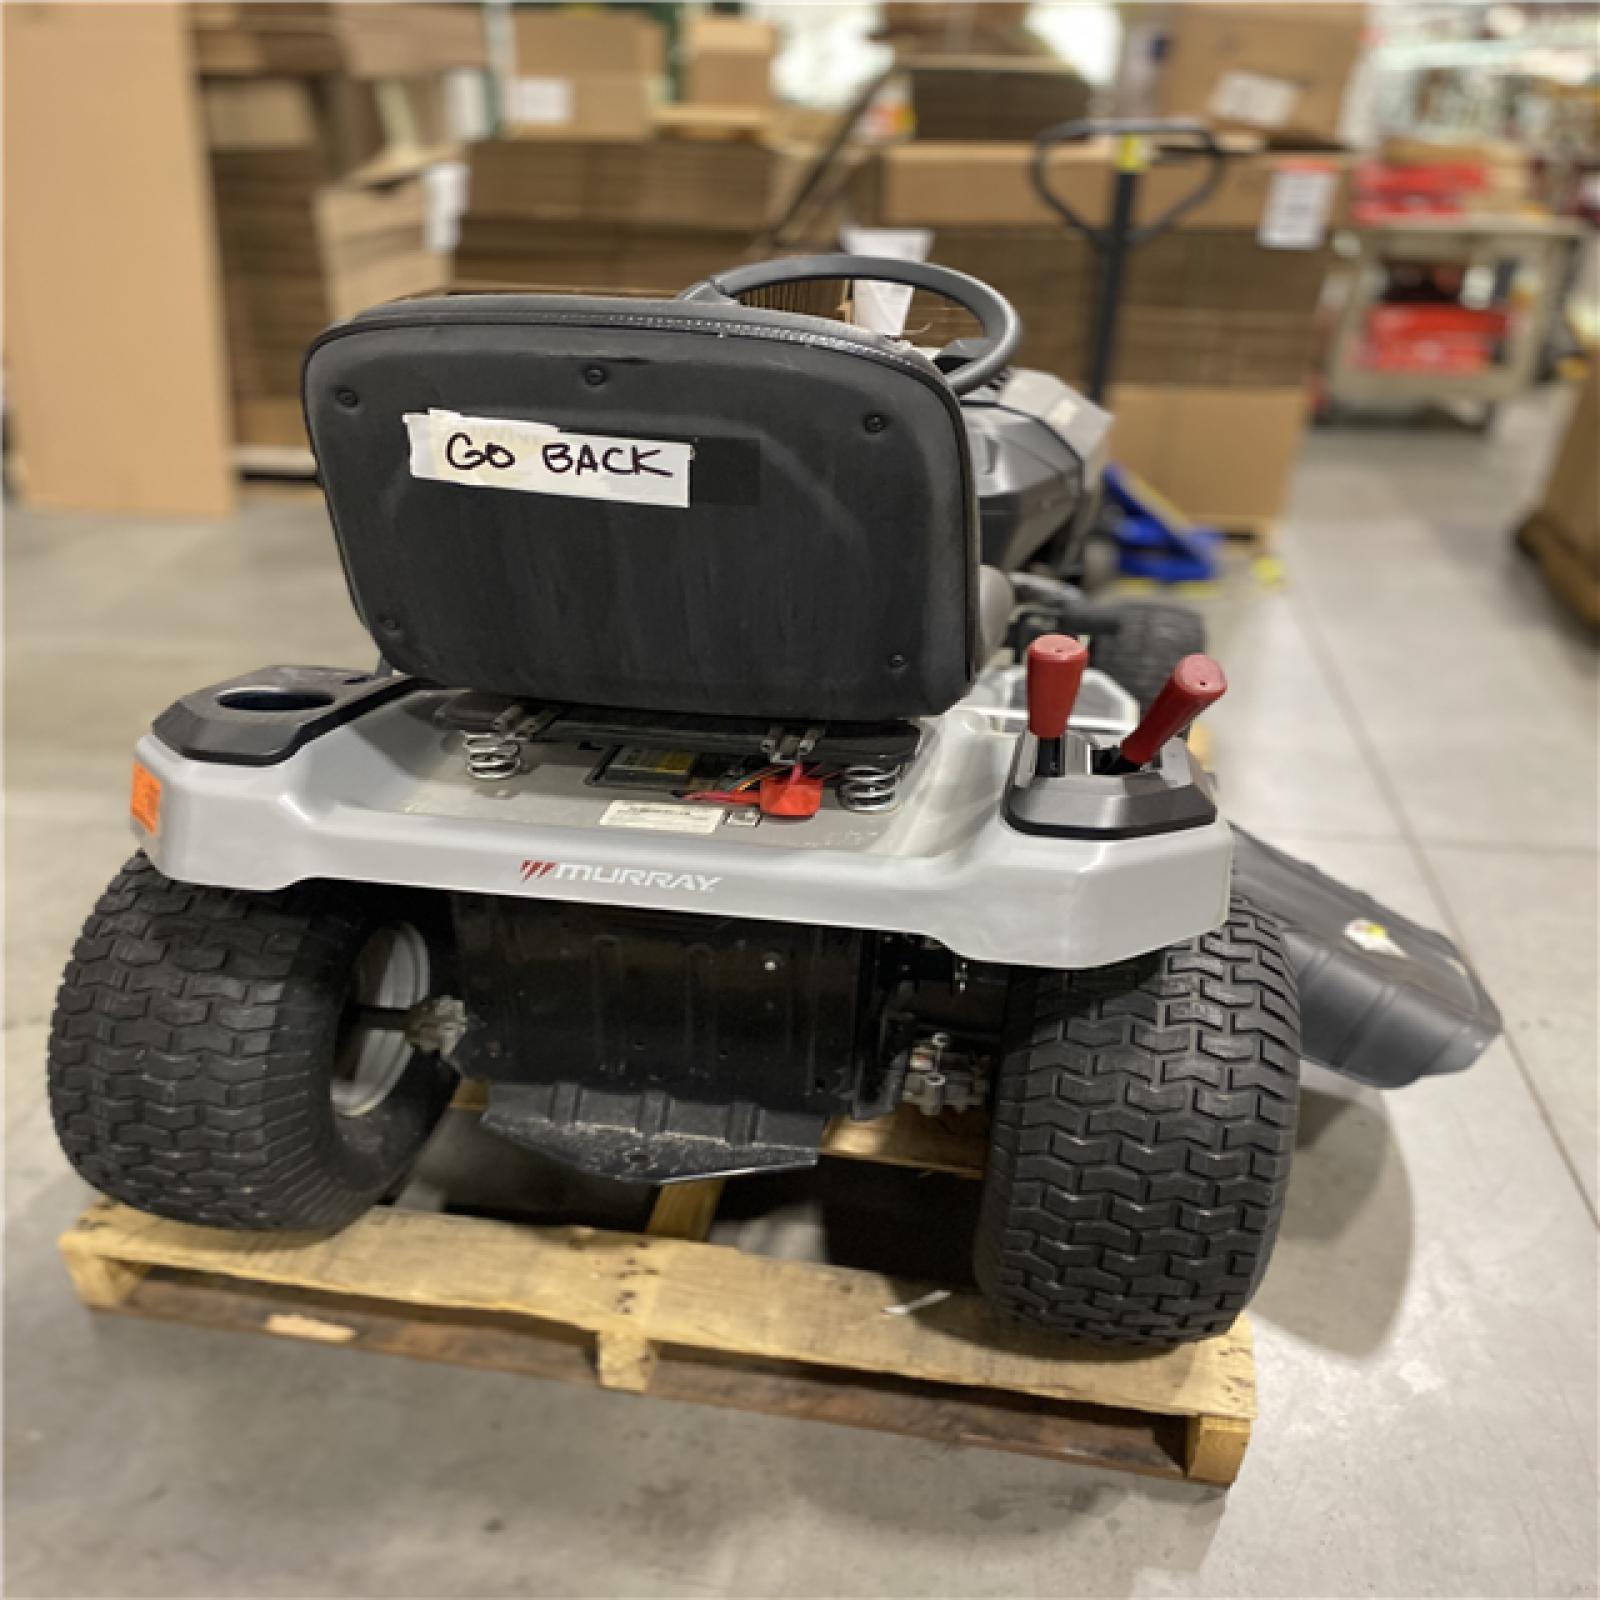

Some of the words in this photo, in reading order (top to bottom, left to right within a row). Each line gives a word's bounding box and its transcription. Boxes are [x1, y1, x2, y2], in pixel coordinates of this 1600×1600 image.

[446, 432, 516, 470] GO
[542, 442, 674, 478] BACK
[555, 863, 723, 892] MURRAY
